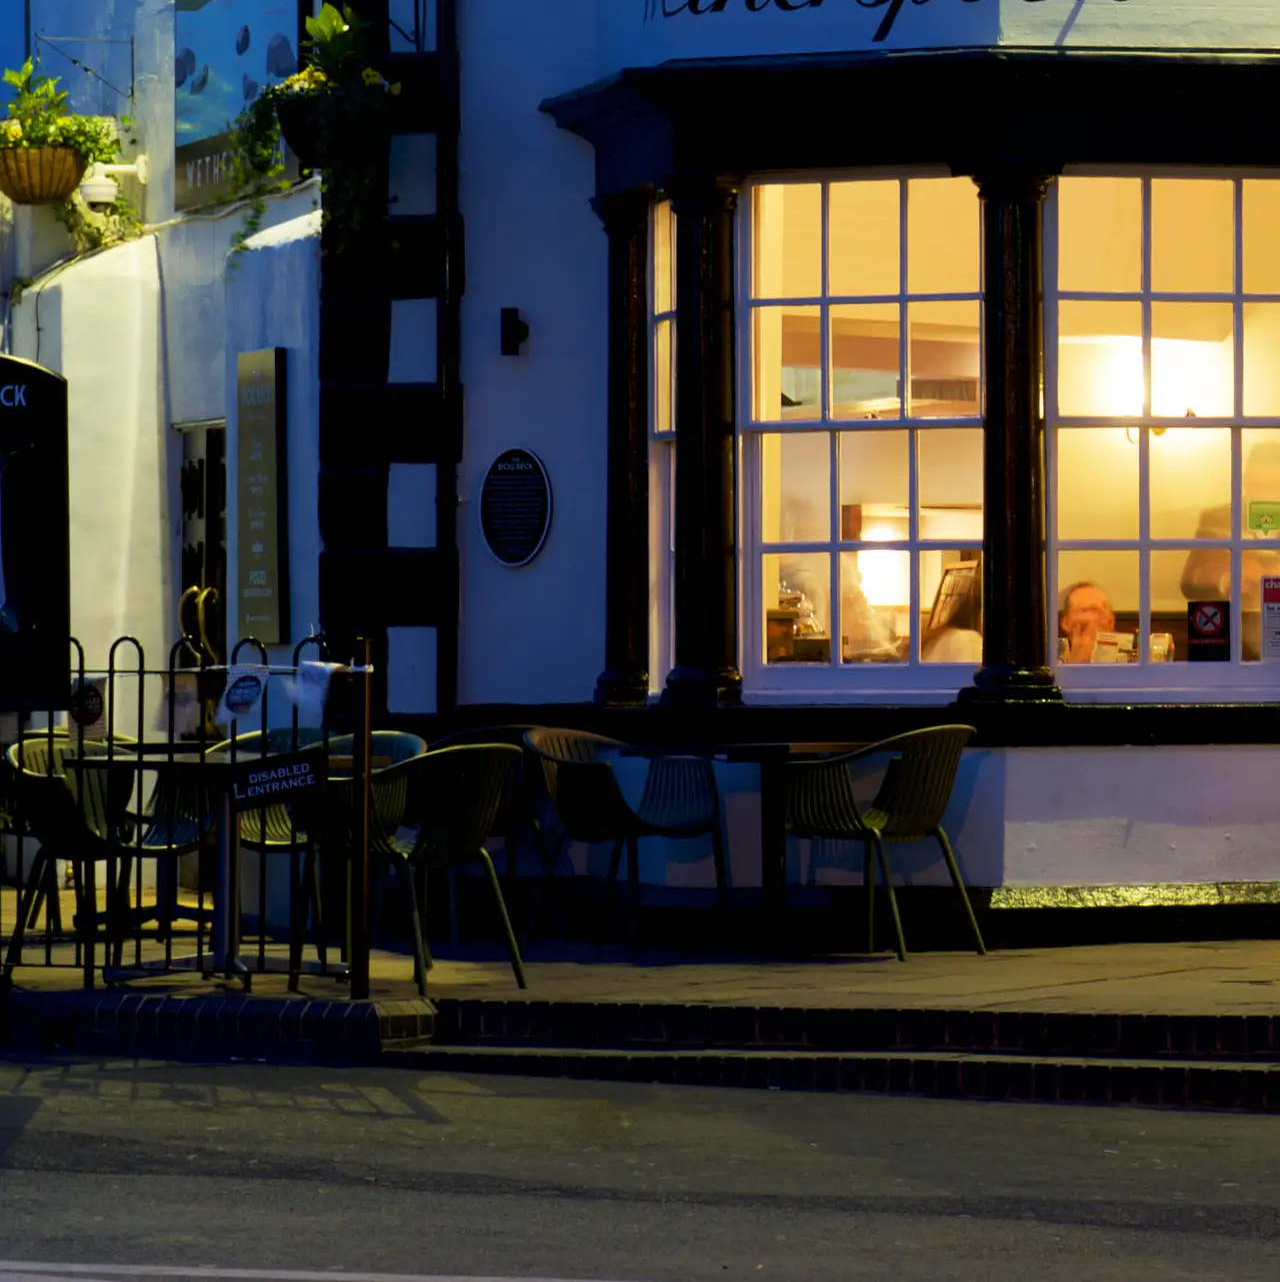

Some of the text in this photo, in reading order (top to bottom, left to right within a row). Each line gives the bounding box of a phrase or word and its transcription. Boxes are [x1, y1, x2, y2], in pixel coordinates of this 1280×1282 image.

[186, 133, 287, 190] WETHEON
[249, 763, 310, 784] DISABLED
[247, 774, 317, 797] ENTRANCE
